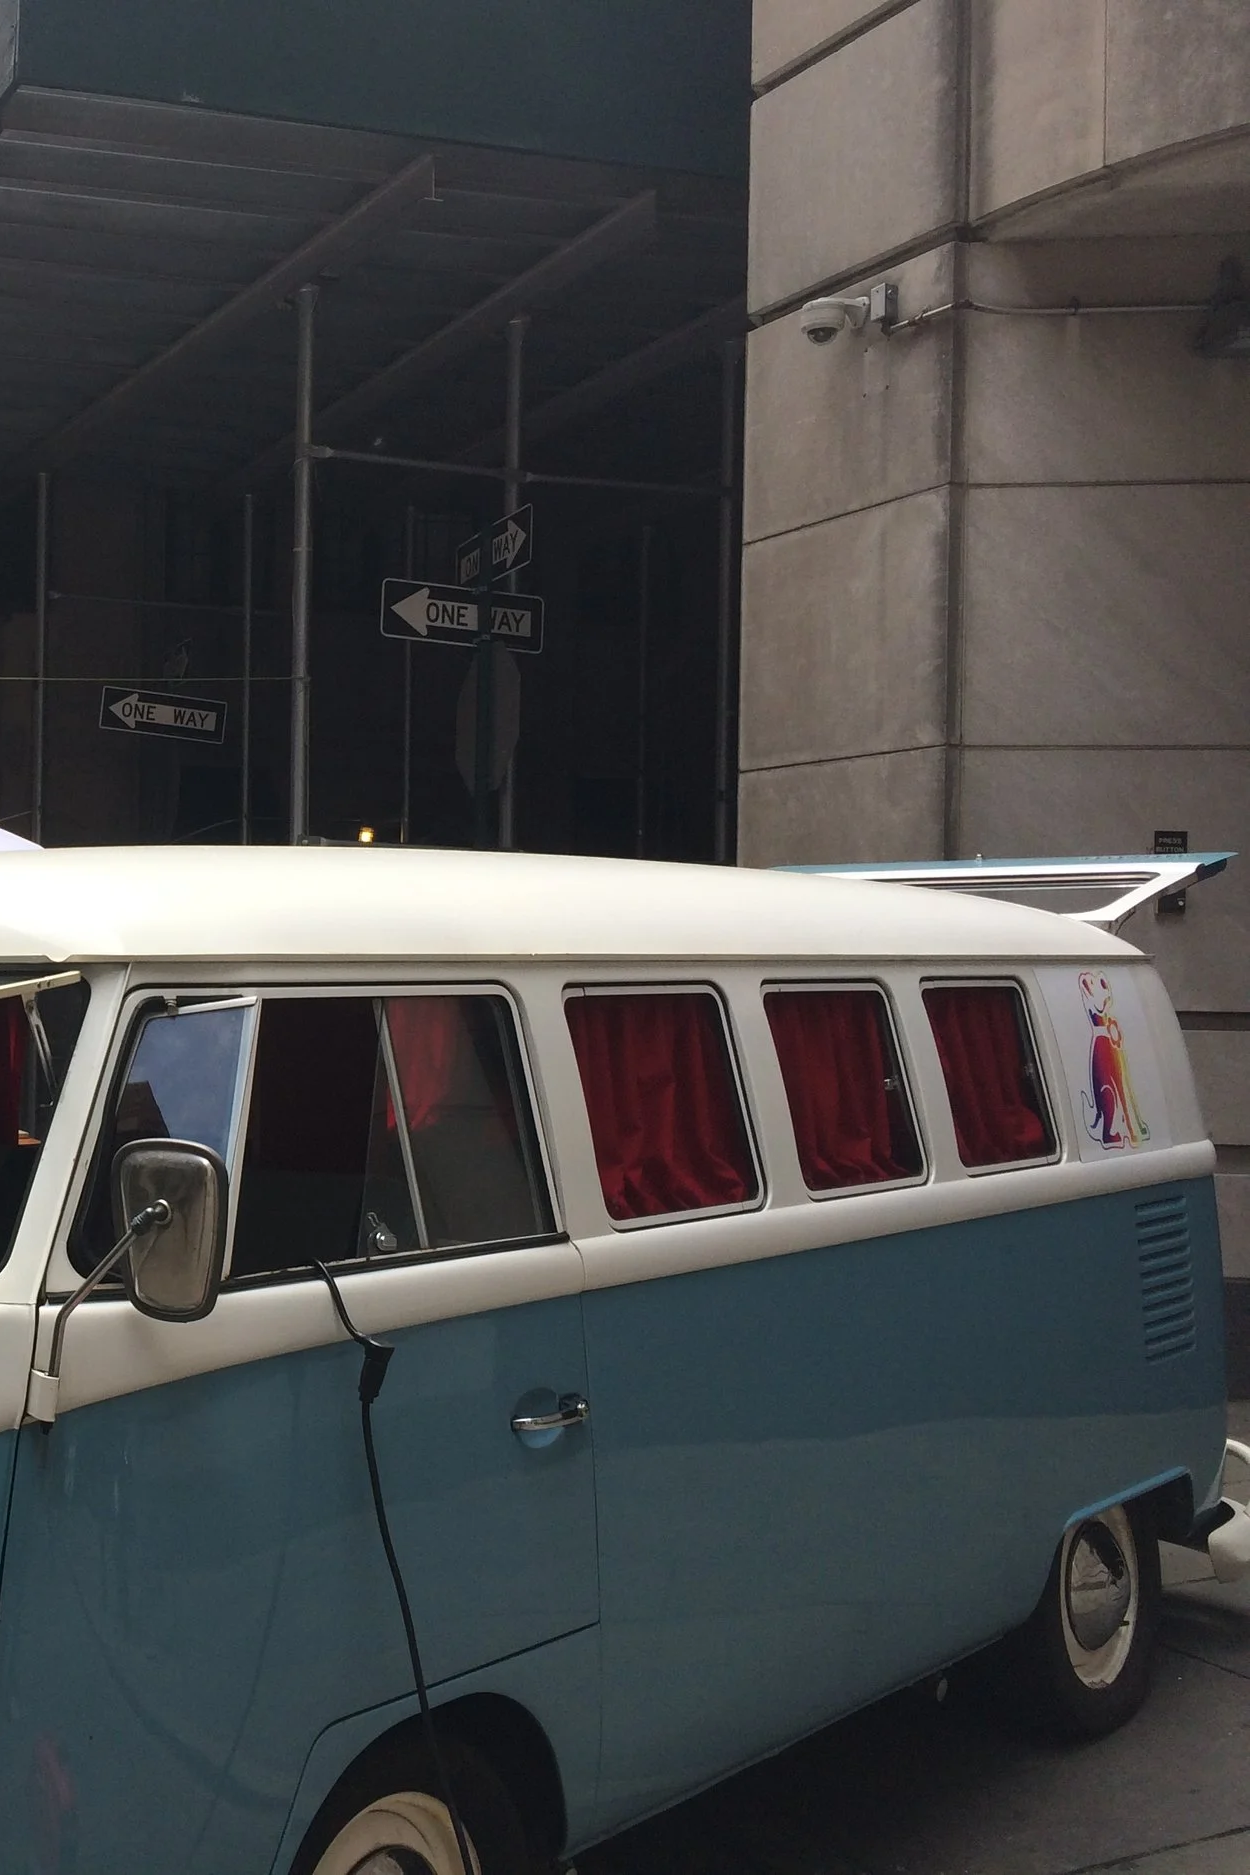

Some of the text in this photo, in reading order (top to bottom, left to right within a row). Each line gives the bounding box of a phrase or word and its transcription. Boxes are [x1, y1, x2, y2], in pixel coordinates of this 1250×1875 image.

[426, 602, 468, 627] ONE
[122, 703, 209, 728] ONE WAY
